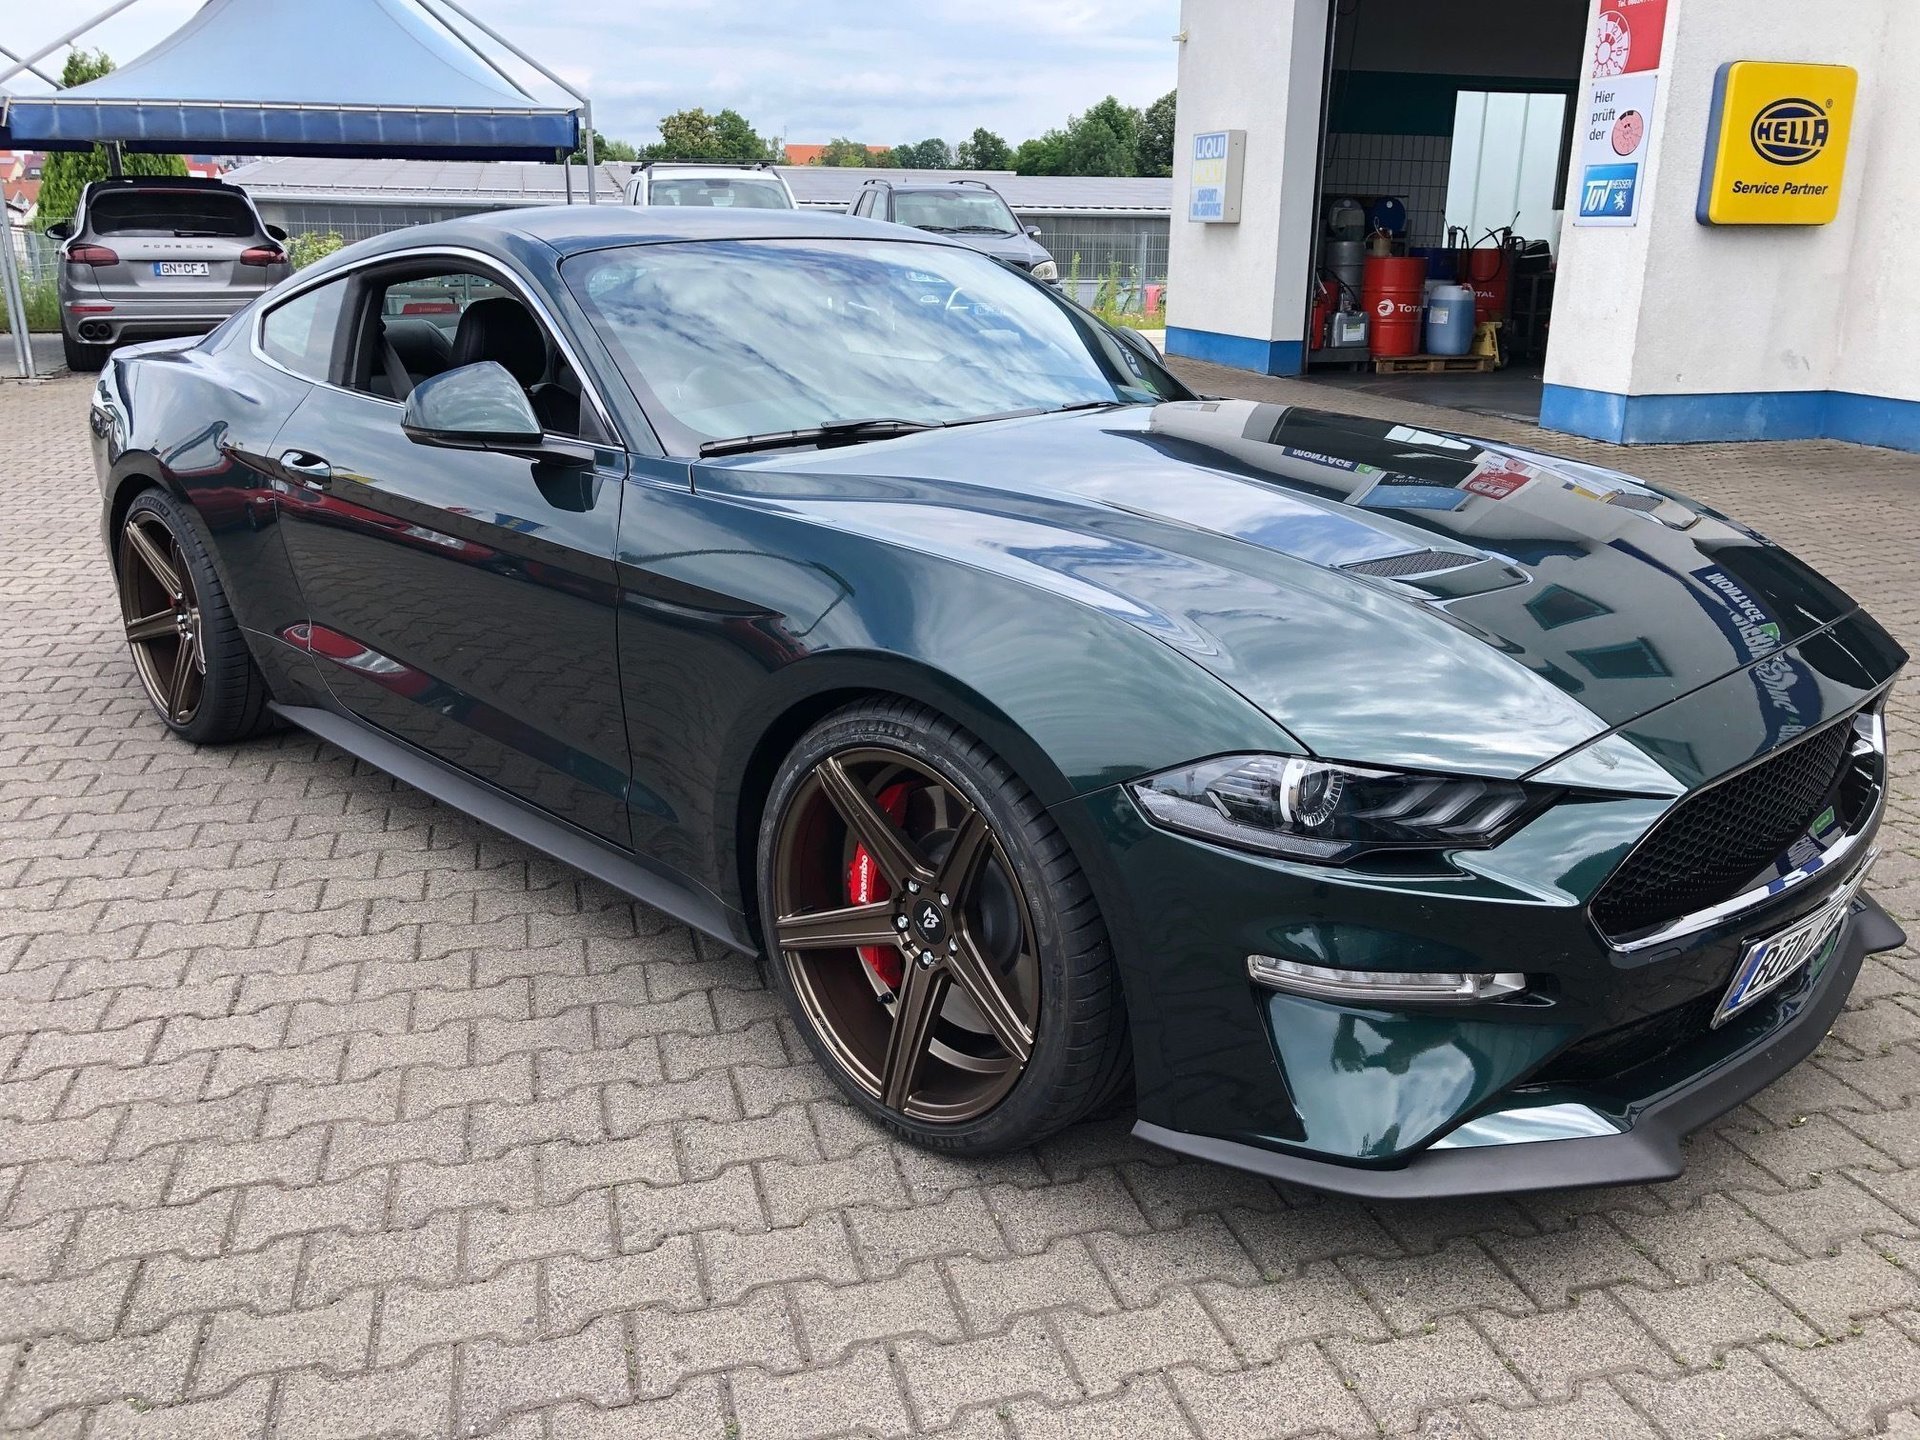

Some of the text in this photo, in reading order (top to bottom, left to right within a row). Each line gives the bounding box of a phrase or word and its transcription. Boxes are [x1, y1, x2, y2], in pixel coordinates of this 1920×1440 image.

[1594, 90, 1615, 104] Hier
[1591, 108, 1616, 125] prüft
[1589, 128, 1606, 141] der
[1757, 118, 1829, 147] HELLA
[1197, 137, 1224, 159] LIQUI
[1611, 178, 1634, 190] HESSEN
[1732, 180, 1829, 196] Service Partner
[161, 263, 177, 275] GN
[1475, 290, 1495, 298] TAL
[1397, 303, 1423, 313] TOTA
[858, 854, 869, 904] brembo
